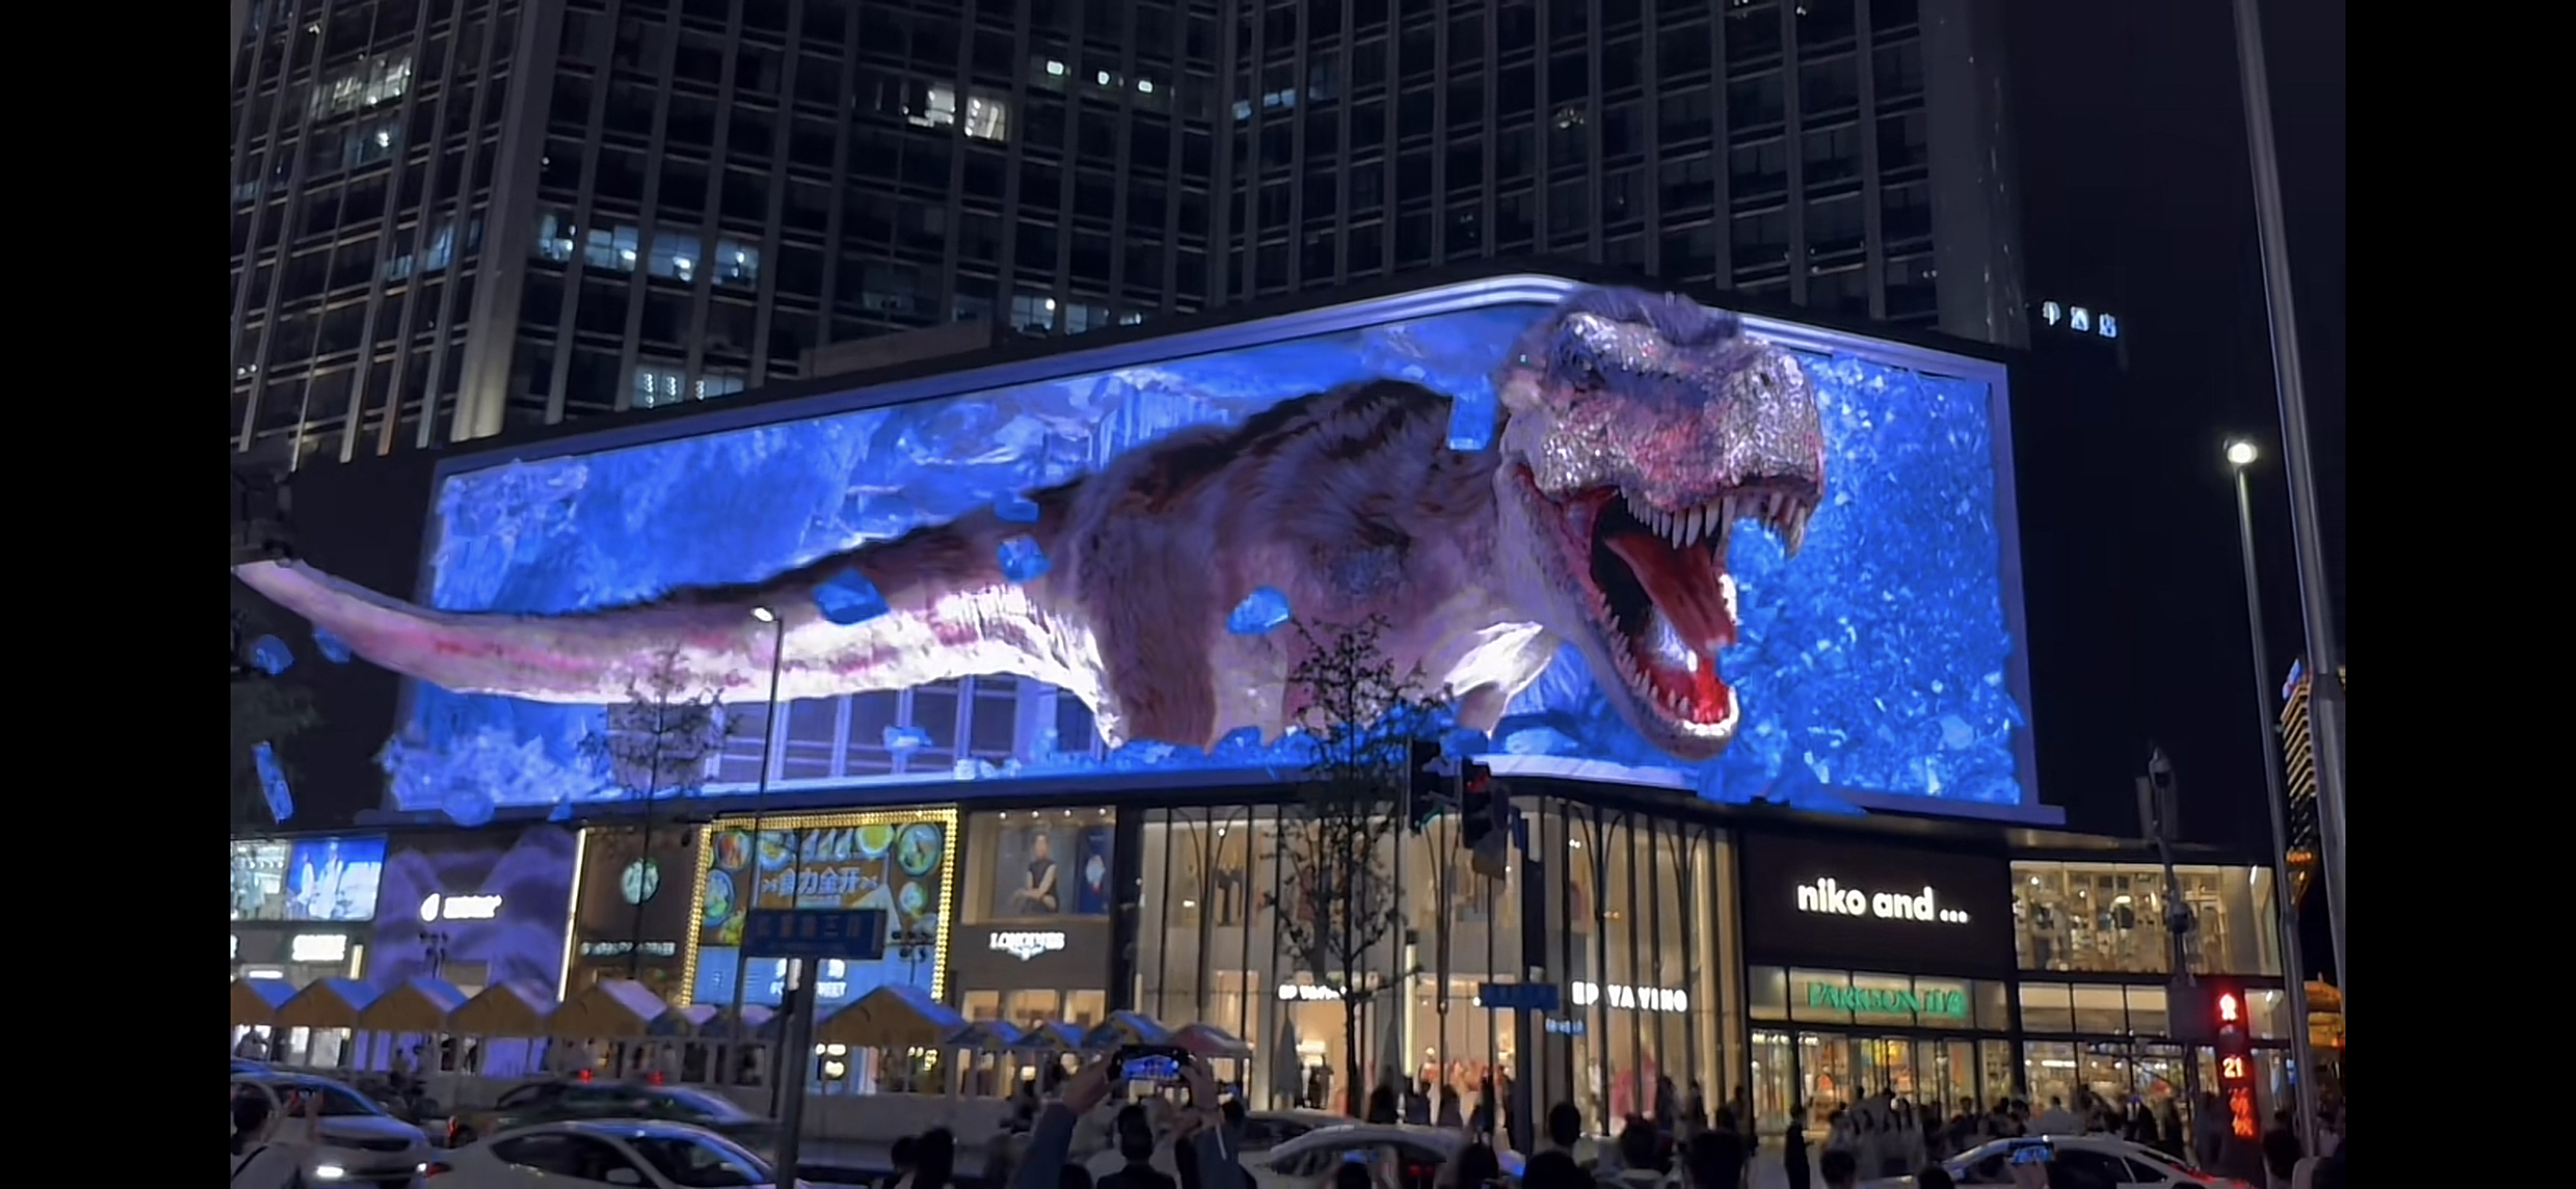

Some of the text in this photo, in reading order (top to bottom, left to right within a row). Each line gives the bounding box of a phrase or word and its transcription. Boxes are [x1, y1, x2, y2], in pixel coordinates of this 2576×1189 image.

[1798, 878, 1867, 915] niko
[1873, 886, 1934, 921] and
[1571, 982, 1599, 1005] EP
[2222, 1057, 2244, 1078] 21
